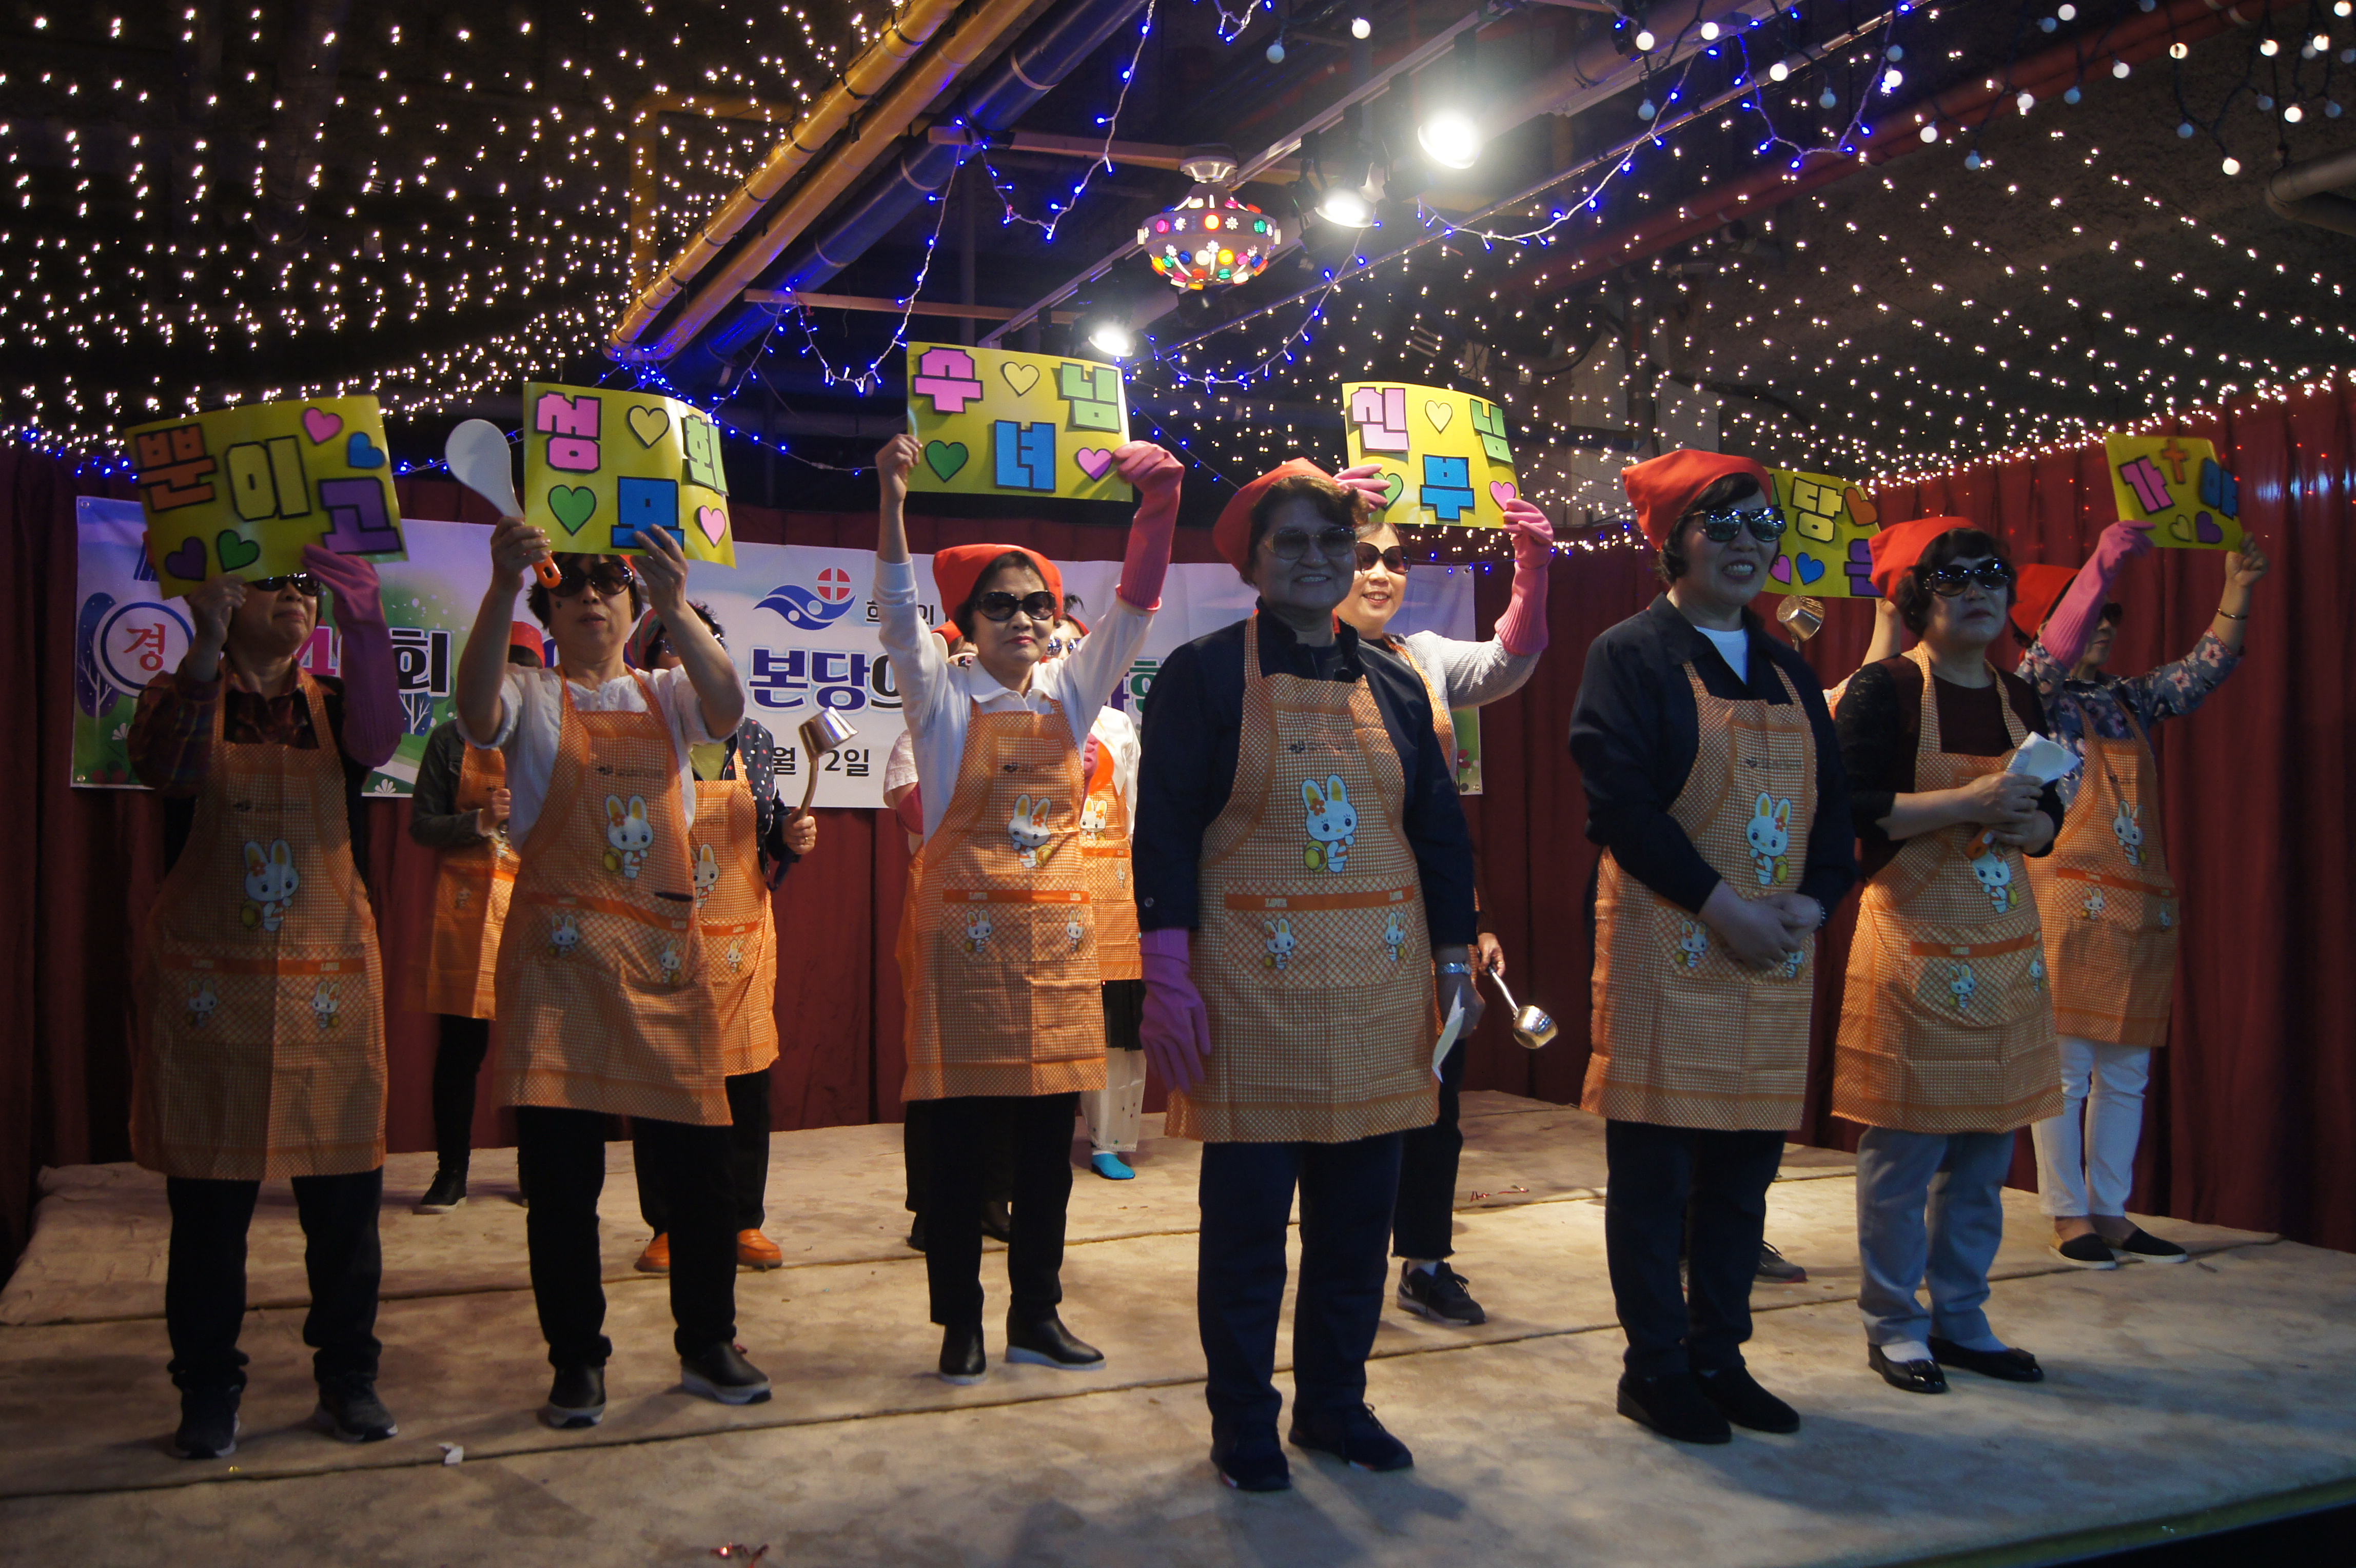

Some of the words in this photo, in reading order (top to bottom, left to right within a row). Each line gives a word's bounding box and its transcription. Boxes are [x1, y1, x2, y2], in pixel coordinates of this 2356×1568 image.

[534, 390, 730, 551] 성모회
[913, 346, 1121, 493] 수녀님
[1350, 386, 1514, 521] 신부님
[134, 422, 403, 554] 뿐이고
[124, 623, 167, 672] 경
